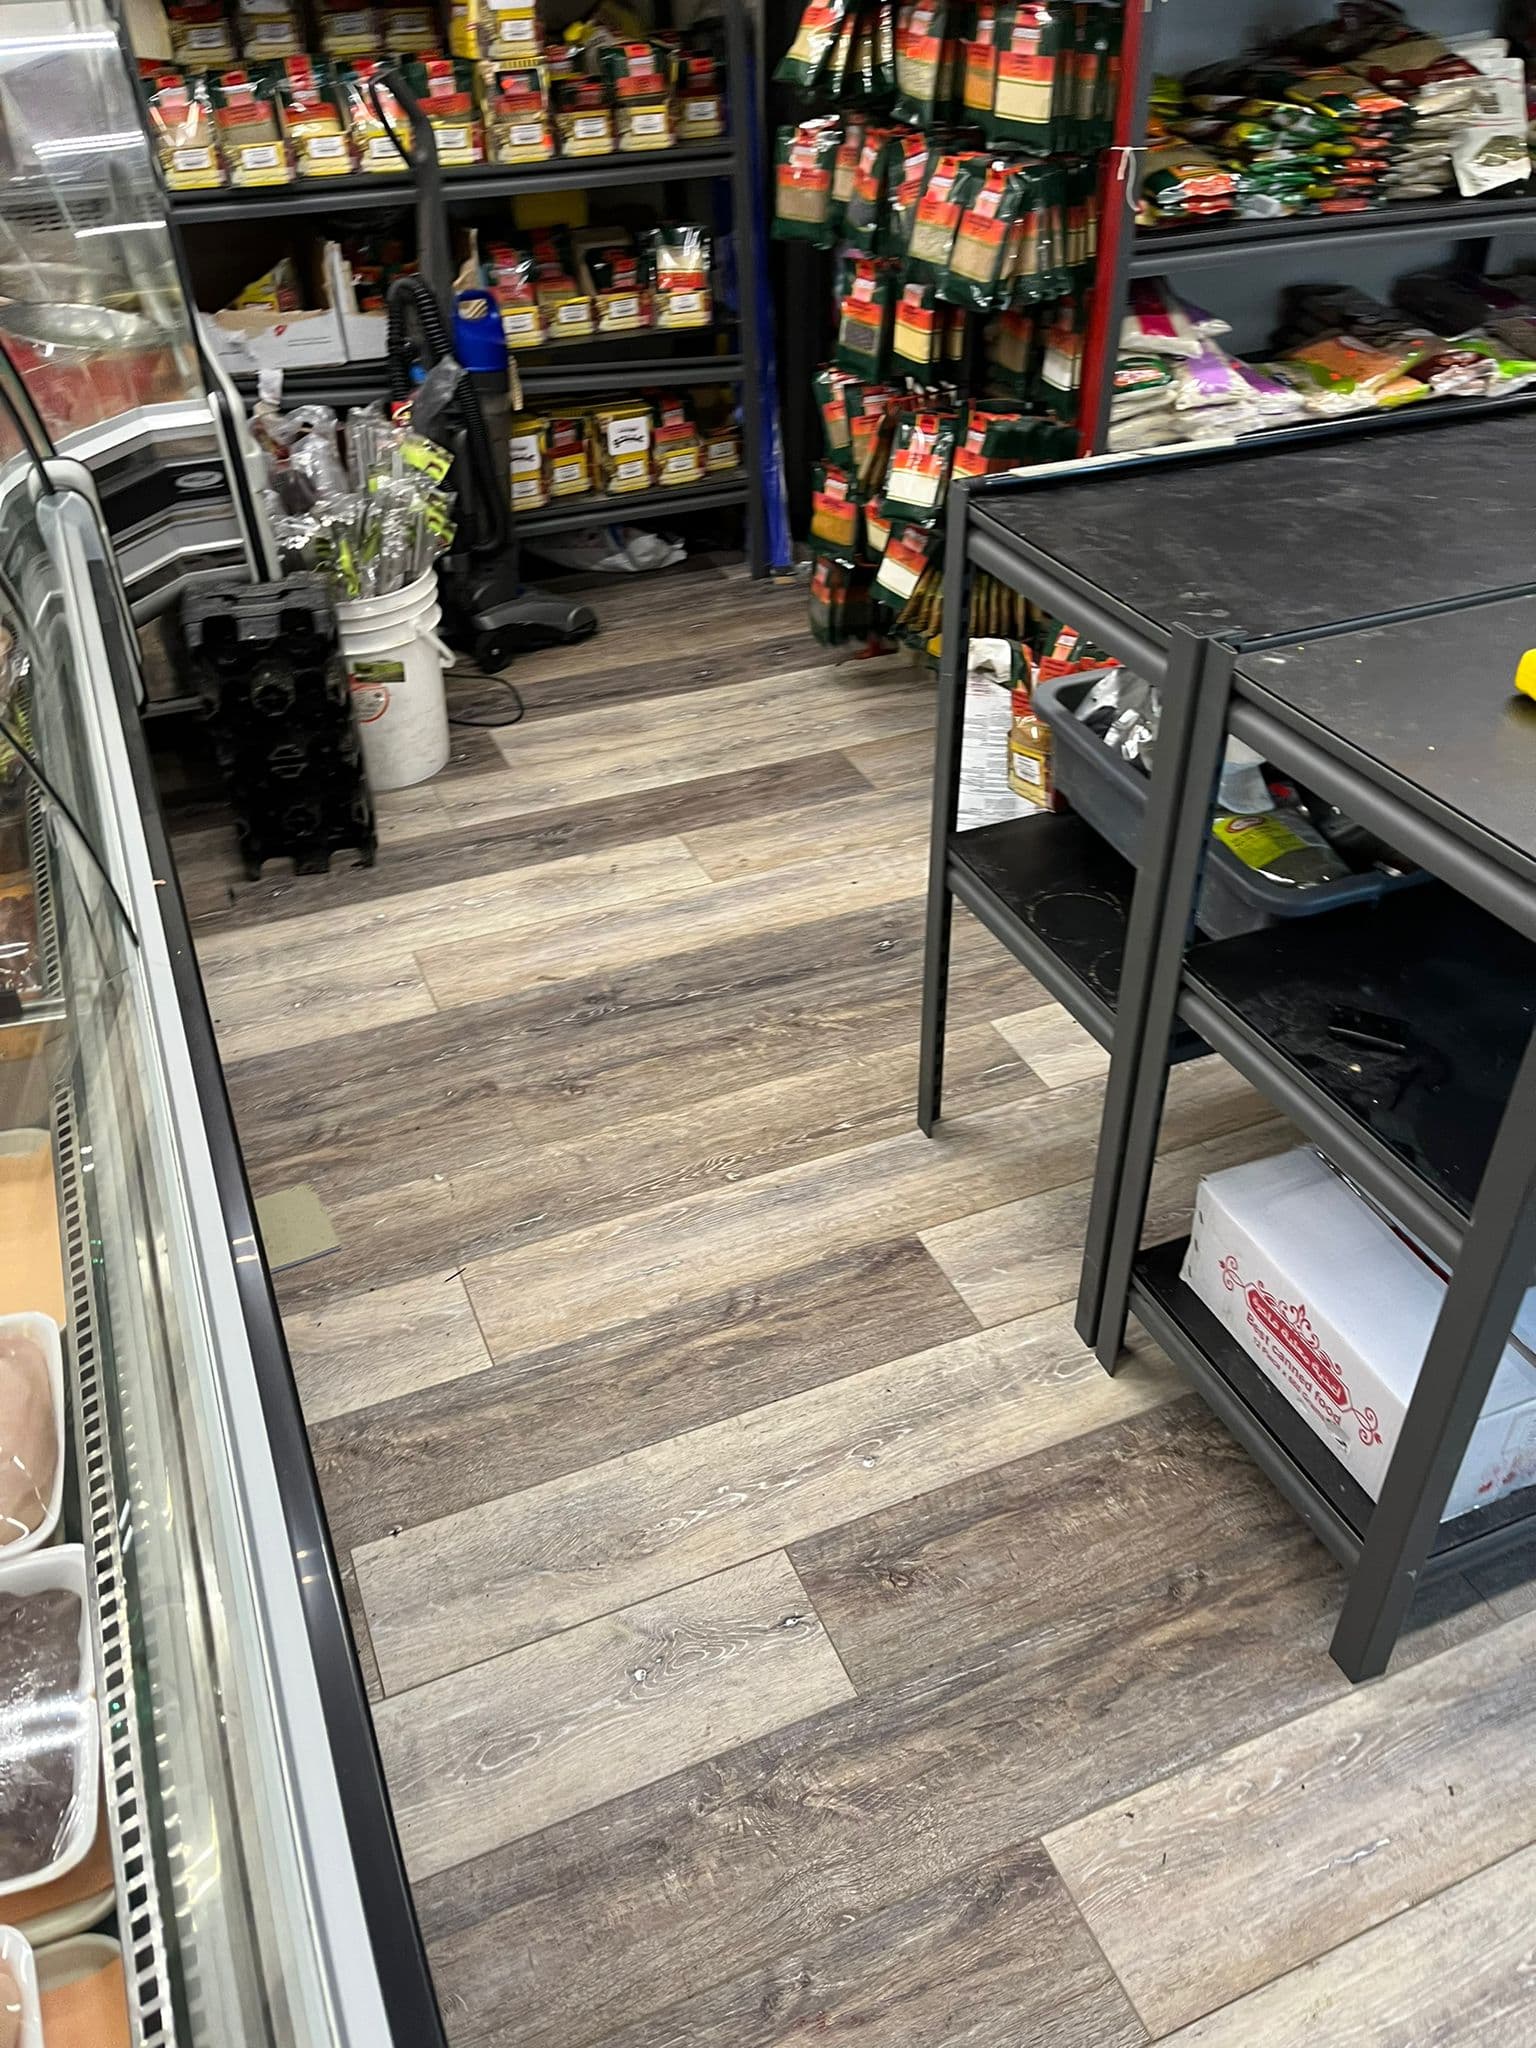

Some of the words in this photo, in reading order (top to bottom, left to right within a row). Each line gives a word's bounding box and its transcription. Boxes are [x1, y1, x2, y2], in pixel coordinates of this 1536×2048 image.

[1247, 1311, 1269, 1343] Best
[1272, 1345, 1312, 1392] canned
[1314, 1391, 1341, 1425] food
